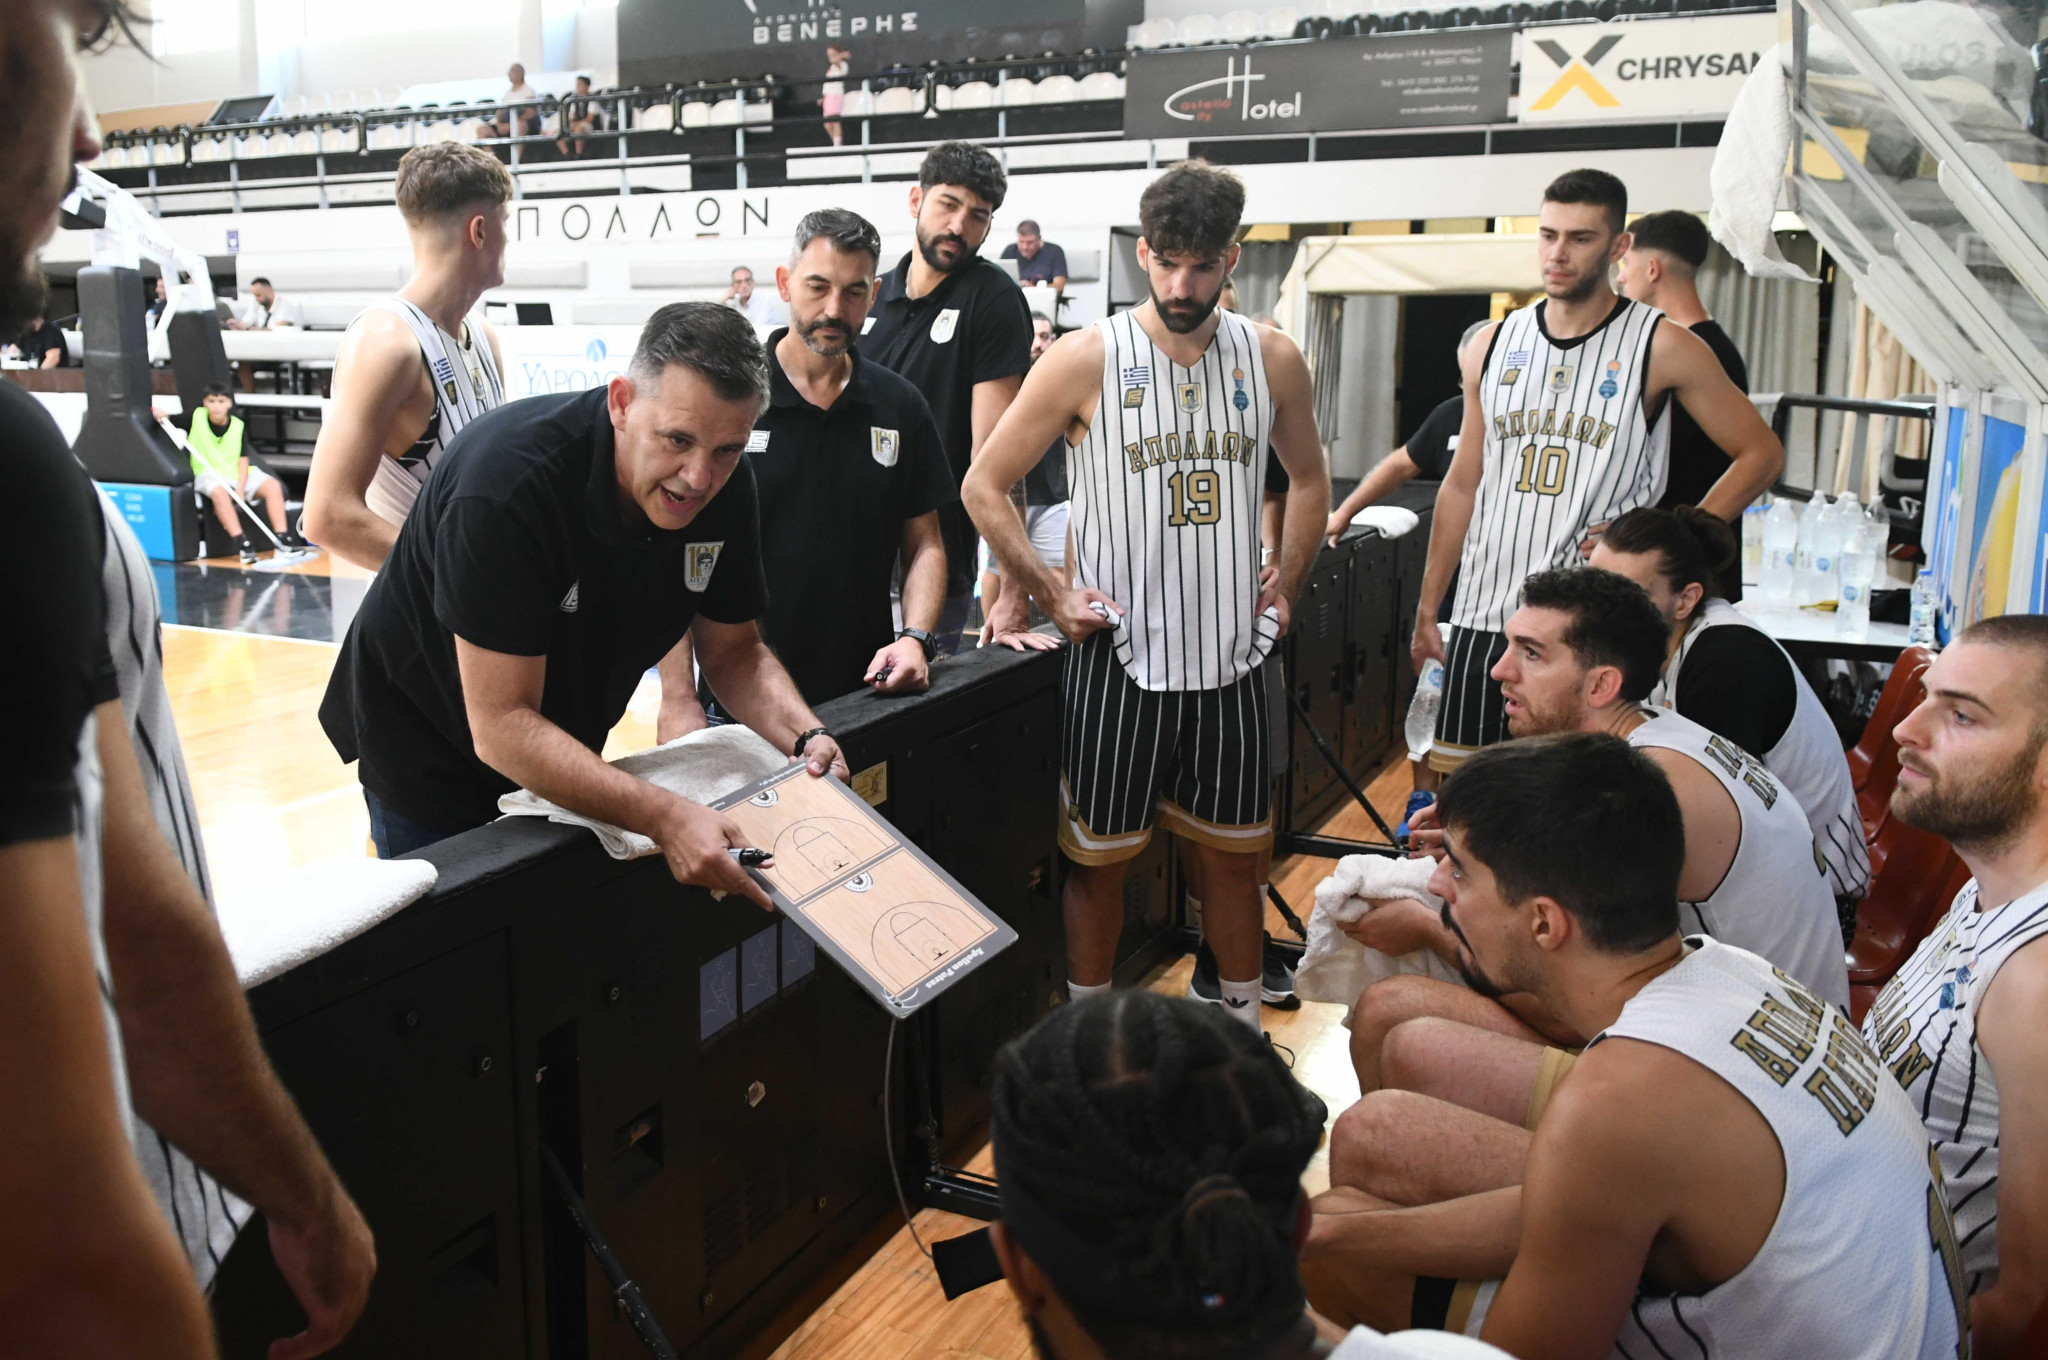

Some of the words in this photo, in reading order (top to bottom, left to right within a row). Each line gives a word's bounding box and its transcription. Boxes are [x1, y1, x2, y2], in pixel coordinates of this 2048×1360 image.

[753, 12, 918, 45] ΒΕΝΕΡΗΣ
[516, 196, 769, 241] ΠΟΛΛΩΝ
[1125, 430, 1256, 474] ΑΠΟΛΛΩΝ
[1515, 443, 1570, 497] 10
[1168, 470, 1222, 527] 19
[925, 967, 955, 989] Patras
[951, 947, 985, 971] Apollon
